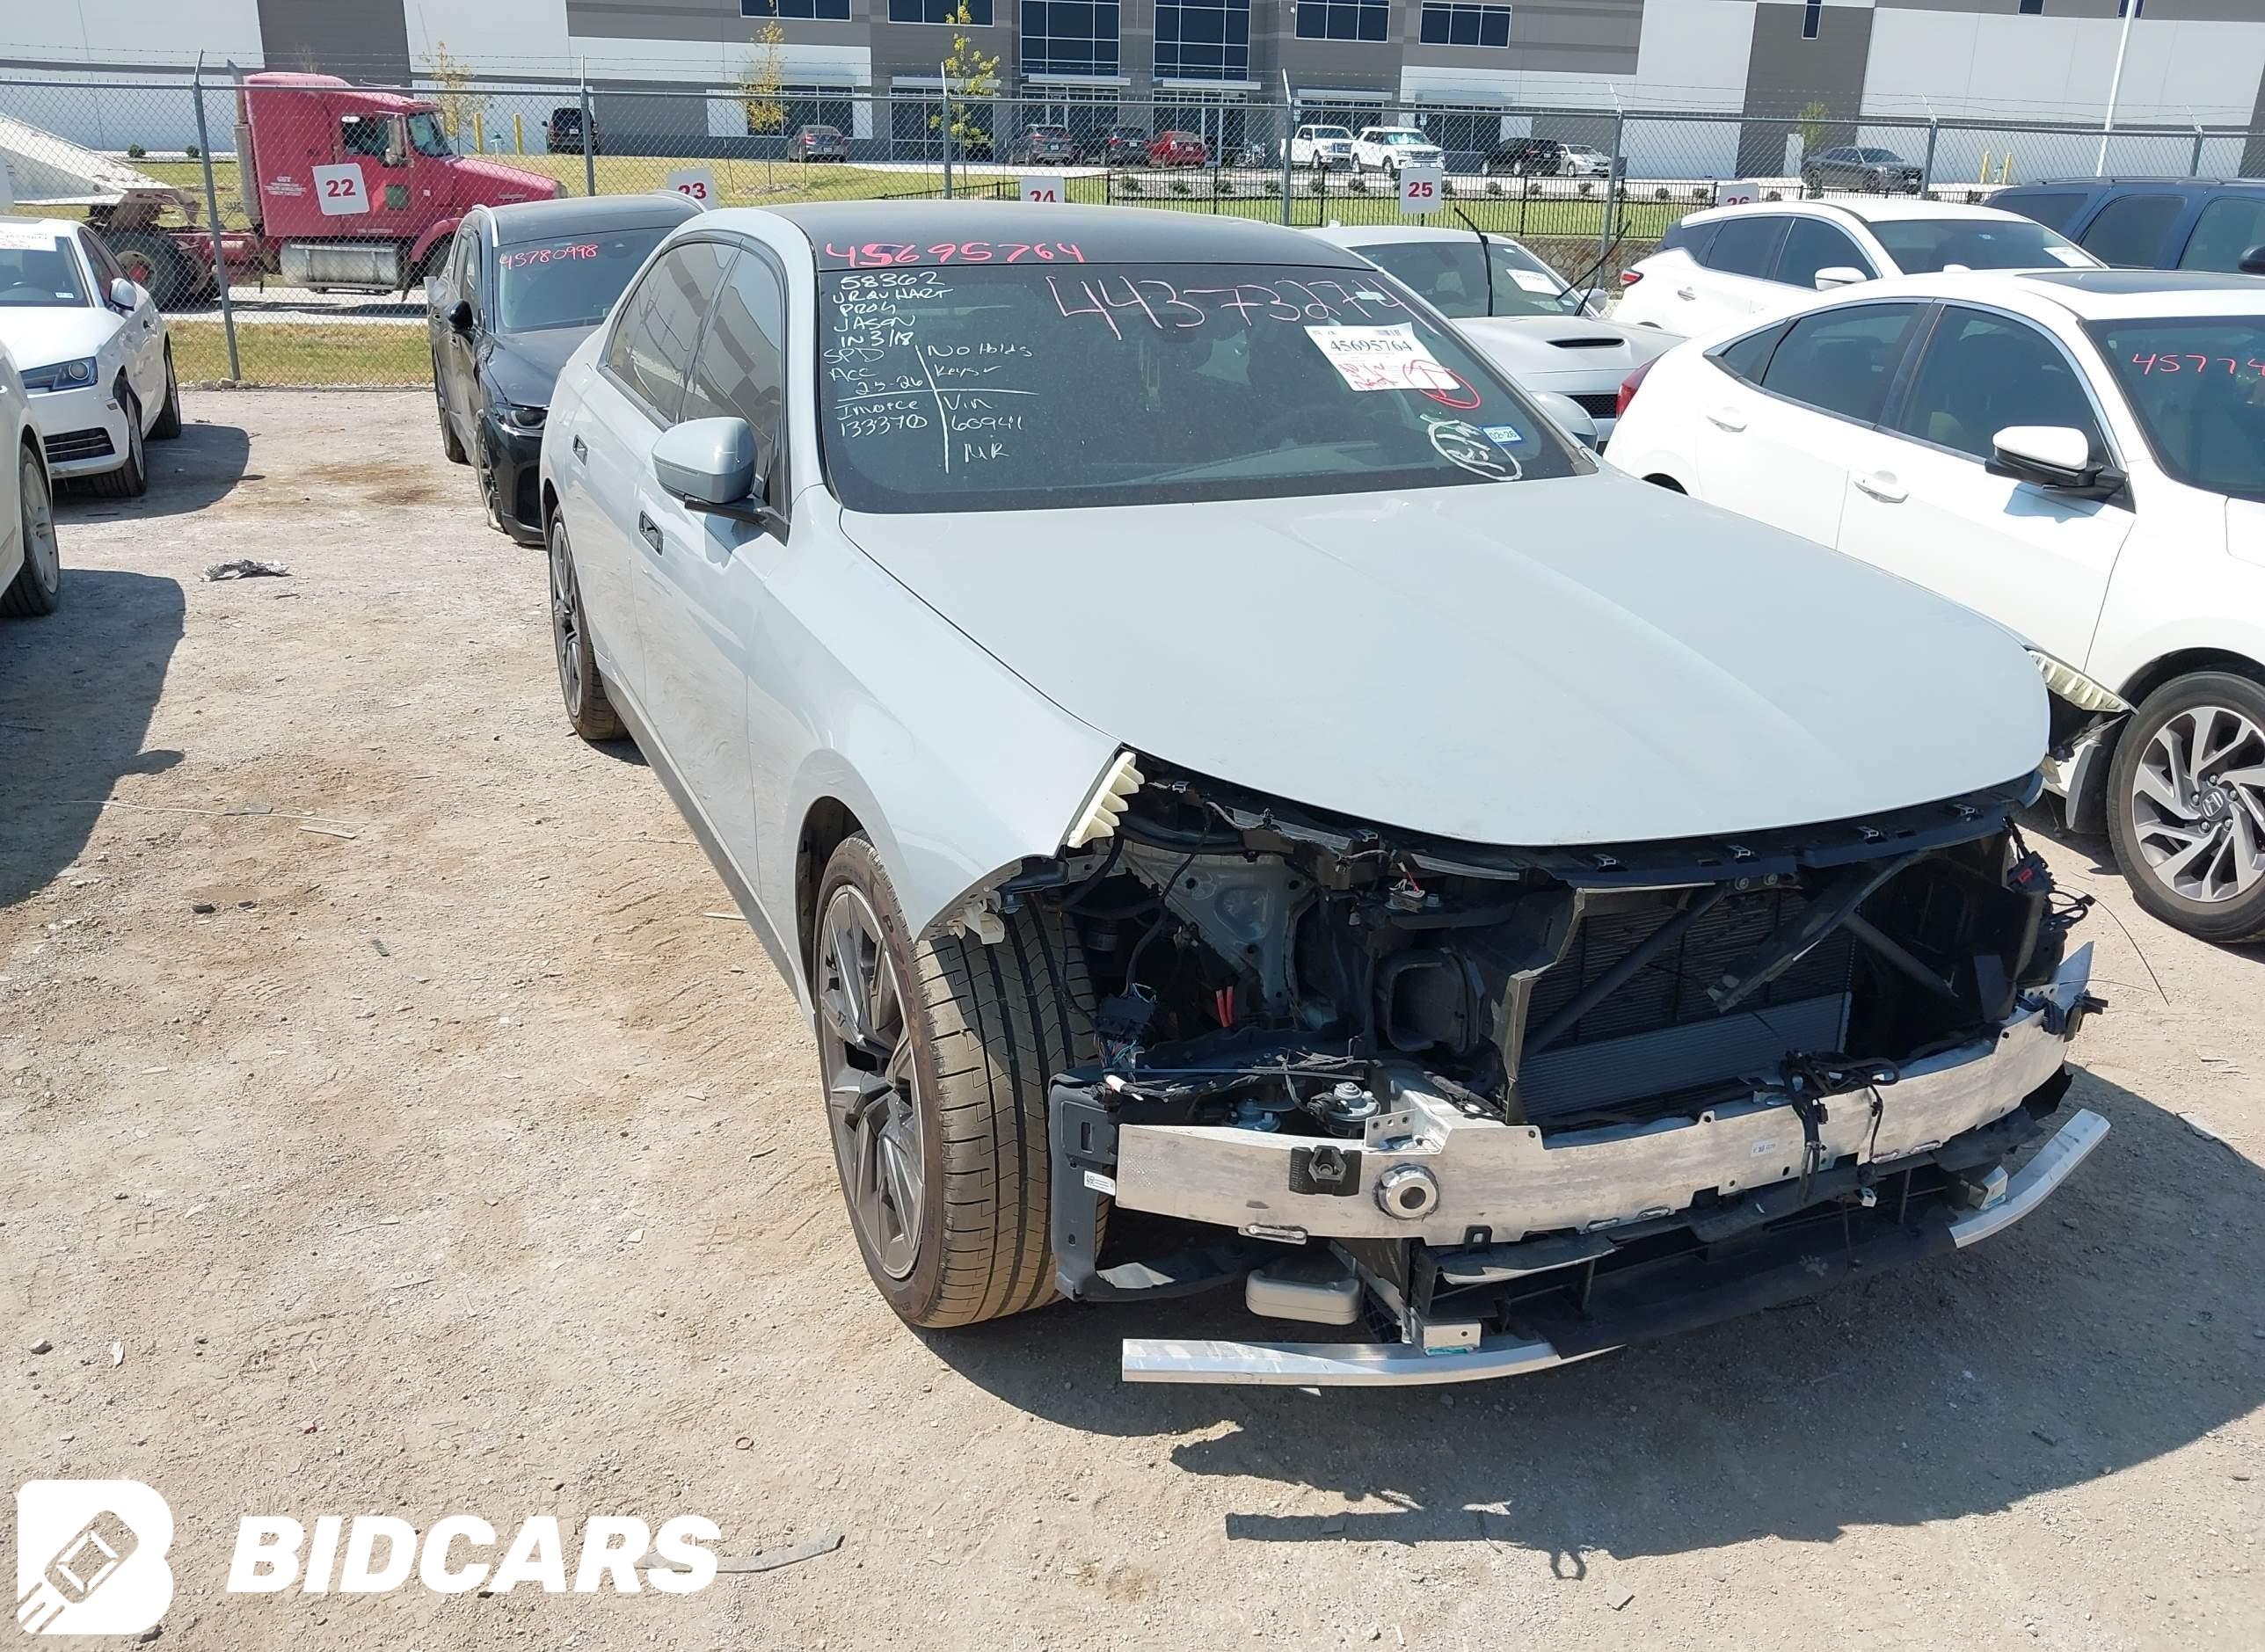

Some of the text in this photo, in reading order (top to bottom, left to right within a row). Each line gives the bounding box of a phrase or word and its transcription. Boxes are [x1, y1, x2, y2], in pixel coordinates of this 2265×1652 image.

[325, 178, 356, 198] 22
[1408, 181, 1433, 198] 25
[499, 244, 599, 271] 45780998
[825, 242, 1085, 268] 45695764
[840, 271, 946, 290] 58362
[1330, 339, 1414, 352] 45695764
